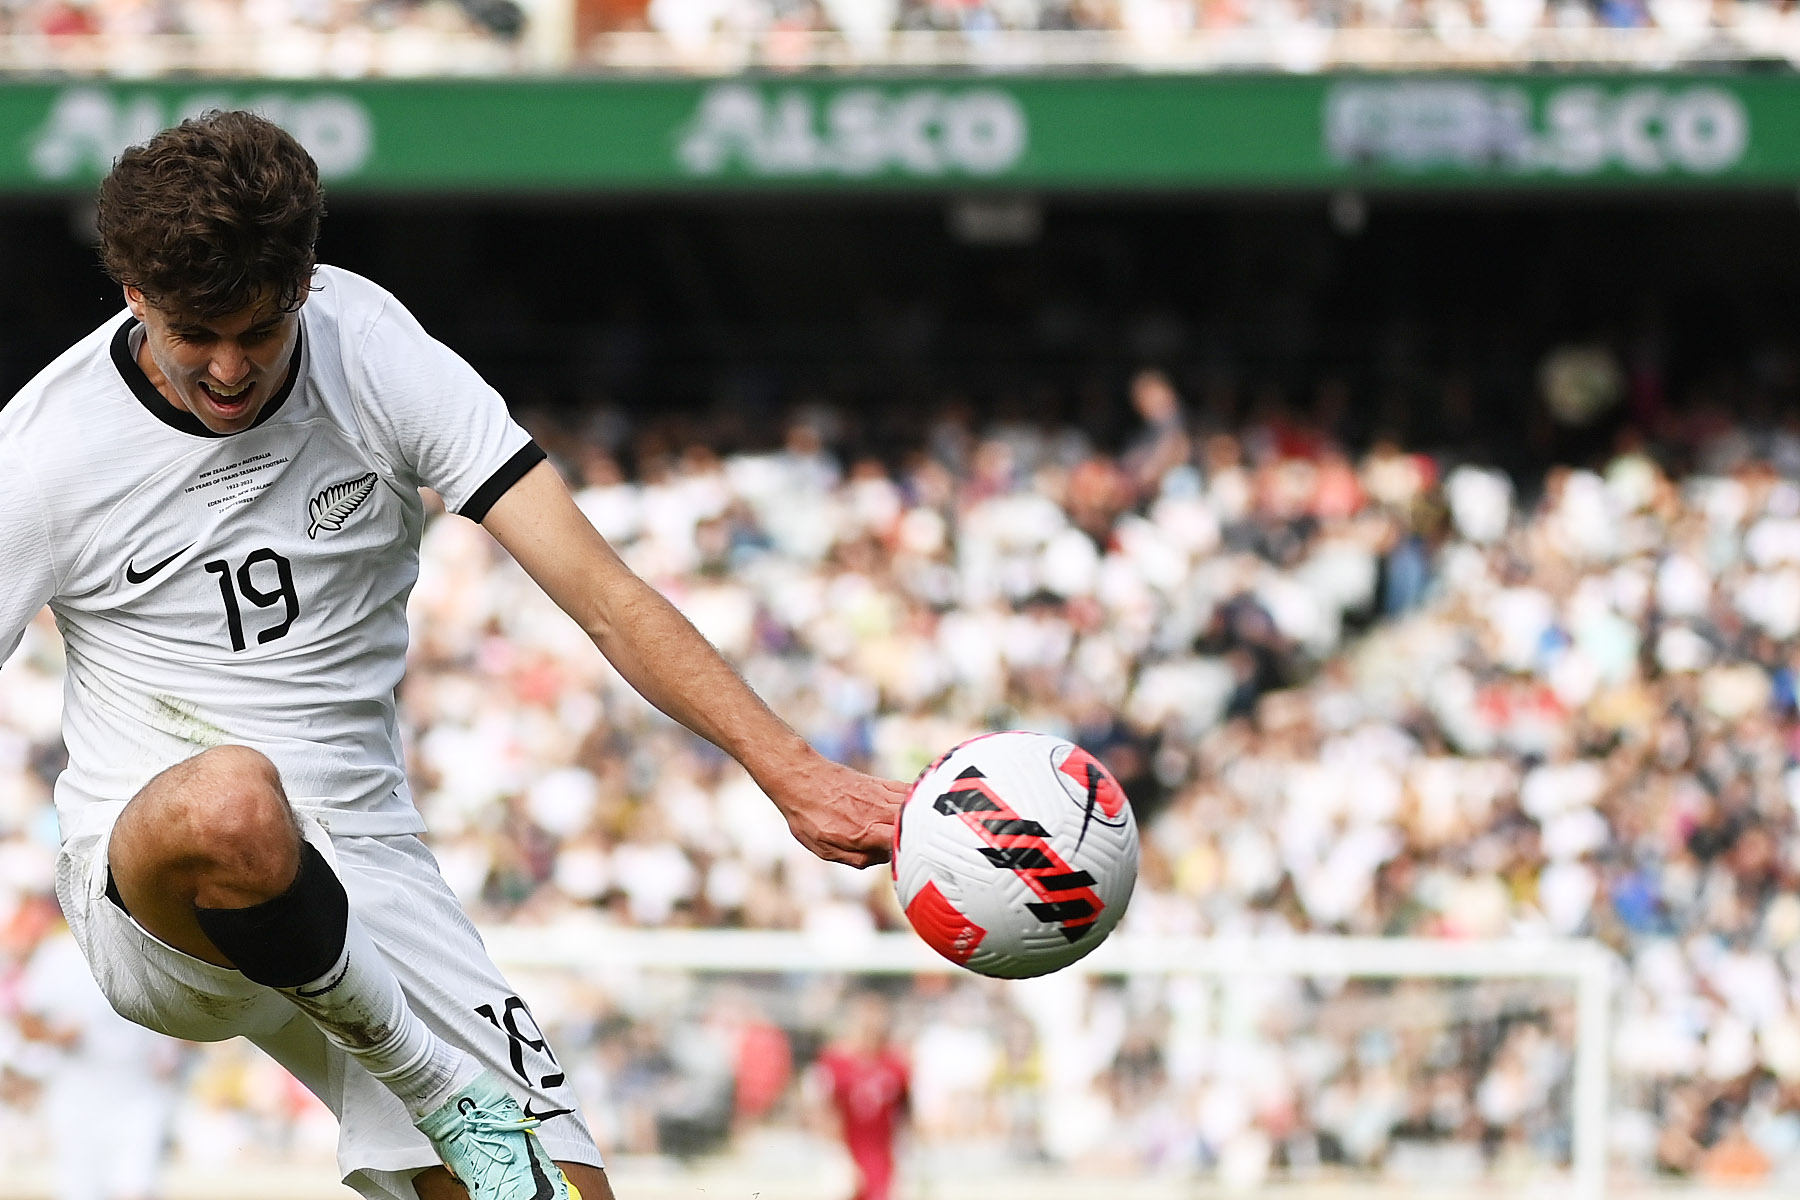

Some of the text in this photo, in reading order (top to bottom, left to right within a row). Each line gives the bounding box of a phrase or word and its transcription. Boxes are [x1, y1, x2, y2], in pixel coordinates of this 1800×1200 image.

[677, 84, 1027, 176] ALSCO
[184, 486, 195, 494] 100
[195, 481, 213, 490] YEARS
[262, 456, 289, 469] FOOTBALL
[199, 471, 212, 479] NEW
[213, 463, 238, 475] ZEALAND
[242, 452, 272, 465] AUSTRALIA
[207, 499, 222, 508] EDEN
[204, 547, 300, 653] 19
[474, 996, 565, 1089] 19
